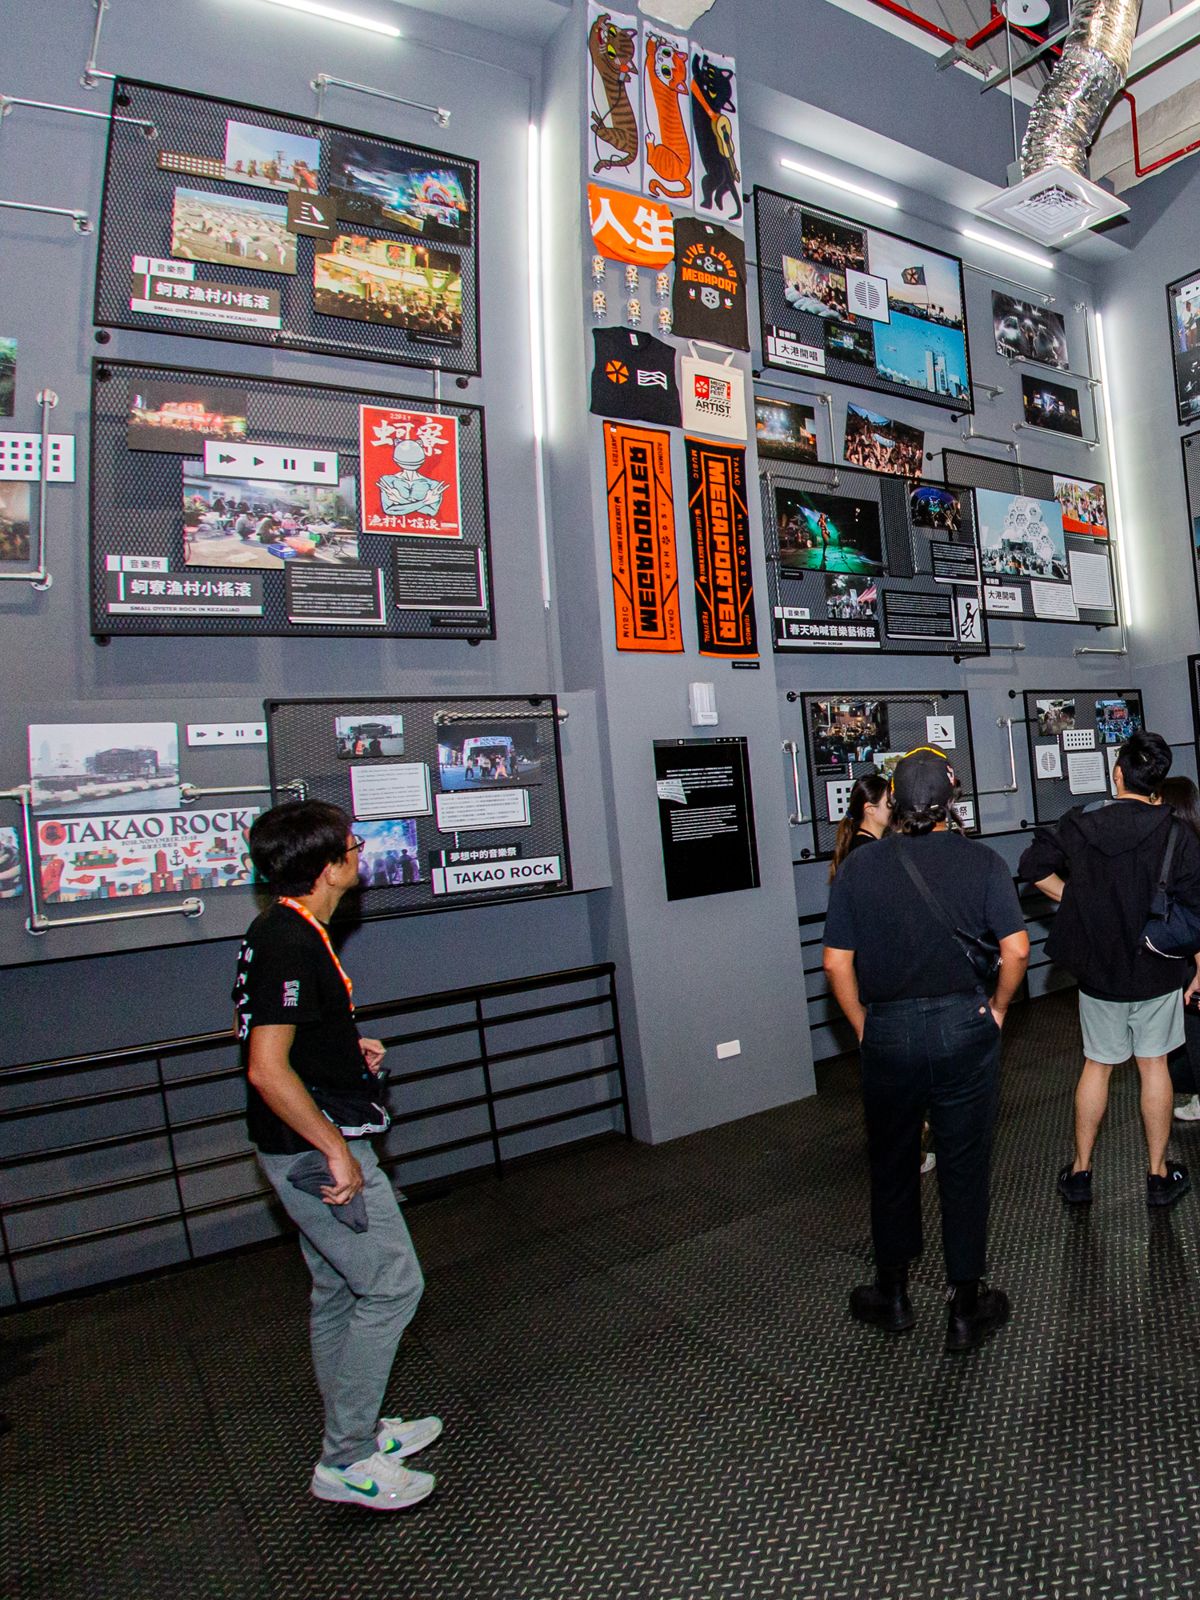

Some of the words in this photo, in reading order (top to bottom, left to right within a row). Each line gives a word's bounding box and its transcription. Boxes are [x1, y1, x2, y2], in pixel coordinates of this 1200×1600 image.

[592, 197, 675, 253] 人生
[682, 243, 706, 265] LIVE
[709, 246, 737, 278] LONG
[703, 256, 716, 272] &
[682, 266, 738, 295] MEGAPORT
[155, 281, 270, 310] 蚵寮漁村小搖滾
[780, 344, 818, 362] 大港開唱
[696, 400, 731, 414] ARTIST
[370, 416, 449, 457] 蚵寮
[691, 449, 699, 480] MUSIC
[732, 457, 741, 486] TAKAO
[130, 559, 161, 569] 音樂祭
[707, 460, 737, 639] MEGAPORTER
[130, 579, 251, 597] 蚵寮漁村小搖滾
[702, 611, 710, 643] FESTIVAL
[789, 623, 876, 638] 春天吶喊音樂藝術祭
[61, 817, 165, 845] TAKAO
[170, 811, 249, 836] ROCK
[450, 847, 517, 863] 夢想中的音樂祭
[453, 868, 506, 885] TAKAO
[510, 863, 555, 879] ROCK
